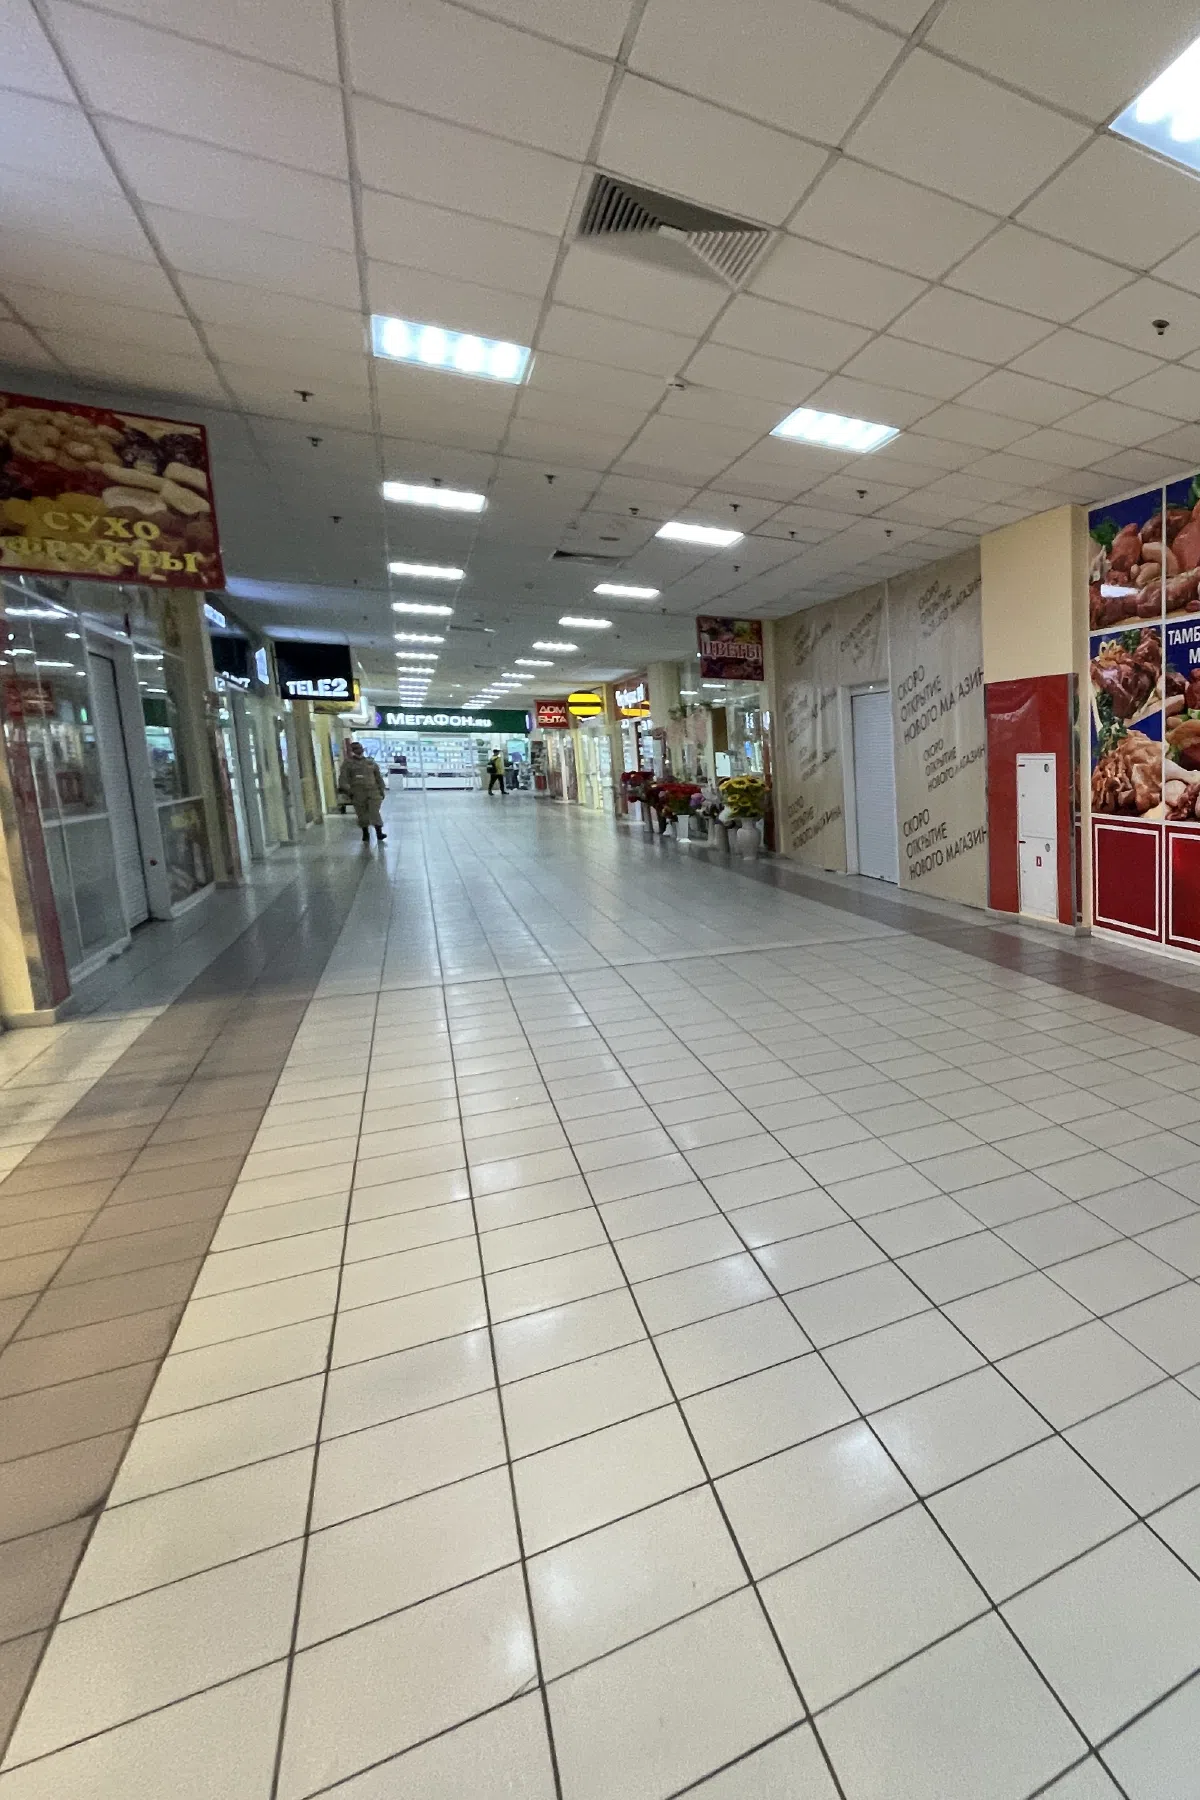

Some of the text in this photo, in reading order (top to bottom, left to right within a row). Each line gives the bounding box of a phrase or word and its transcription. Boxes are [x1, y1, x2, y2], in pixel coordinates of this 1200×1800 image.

[43, 511, 161, 540] СУХО
[286, 678, 349, 697] TELE2
[898, 665, 925, 701] СКОРО
[538, 705, 566, 714] ДОМ
[538, 715, 567, 724] БЫТА
[904, 705, 938, 745] НОВОГО
[903, 808, 930, 838] СКОРО
[906, 822, 948, 859] ОТКРЫТИЕ
[909, 849, 944, 880] НОВОГО
